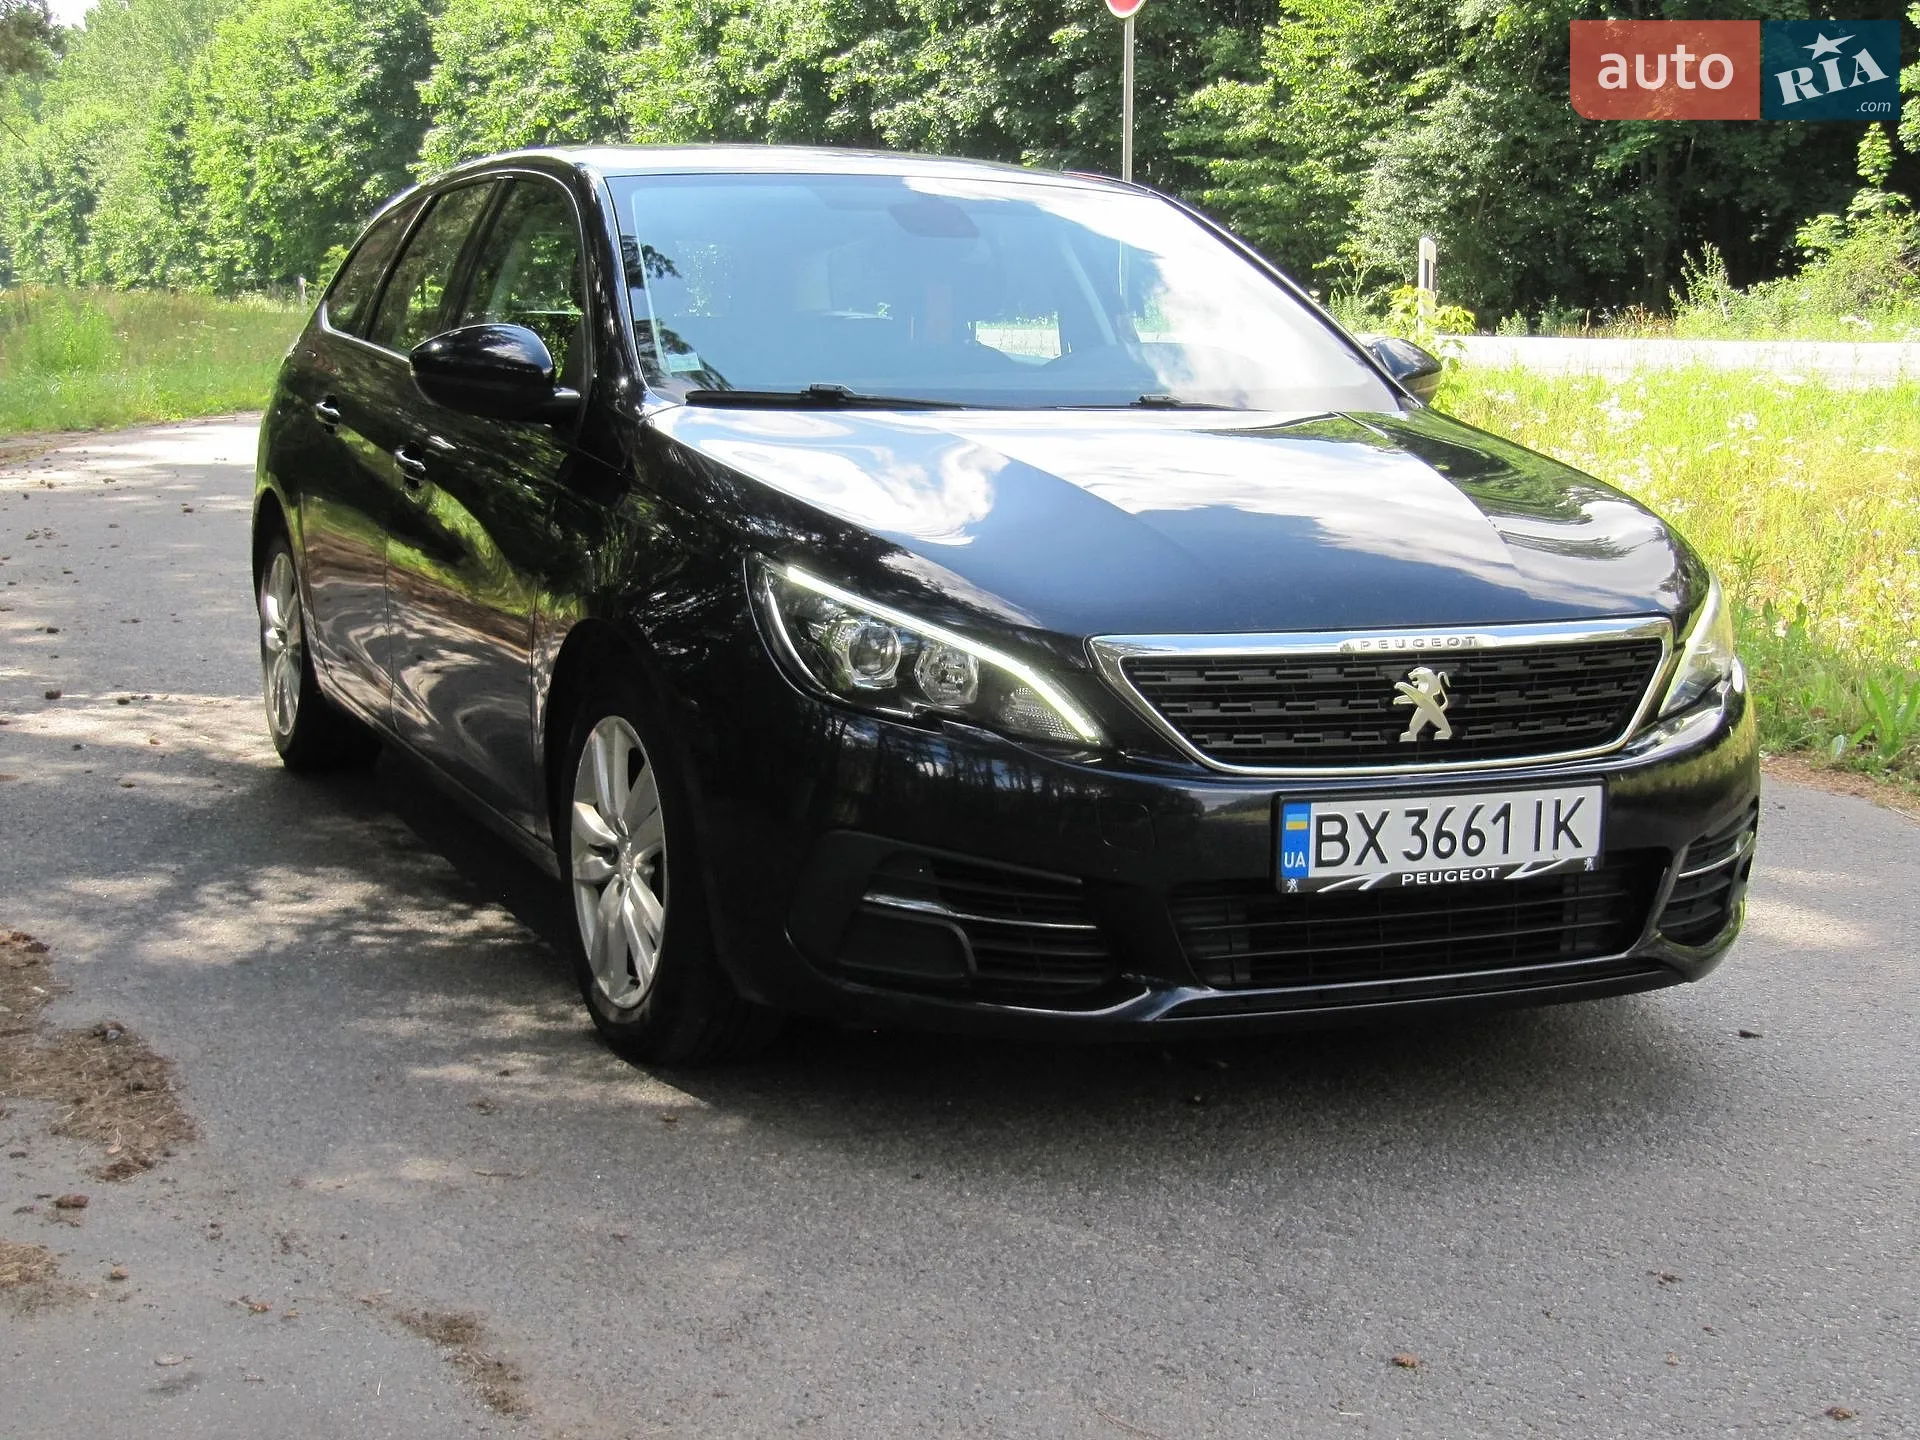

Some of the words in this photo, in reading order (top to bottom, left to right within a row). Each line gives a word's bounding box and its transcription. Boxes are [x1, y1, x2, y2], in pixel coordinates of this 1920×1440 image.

[1360, 636, 1476, 650] PEUGEOT
[1314, 809, 1391, 868] BX
[1402, 801, 1512, 862] 3661
[1534, 796, 1586, 852] IK
[1284, 851, 1306, 869] UA
[1401, 866, 1500, 886] PEUGEOT
